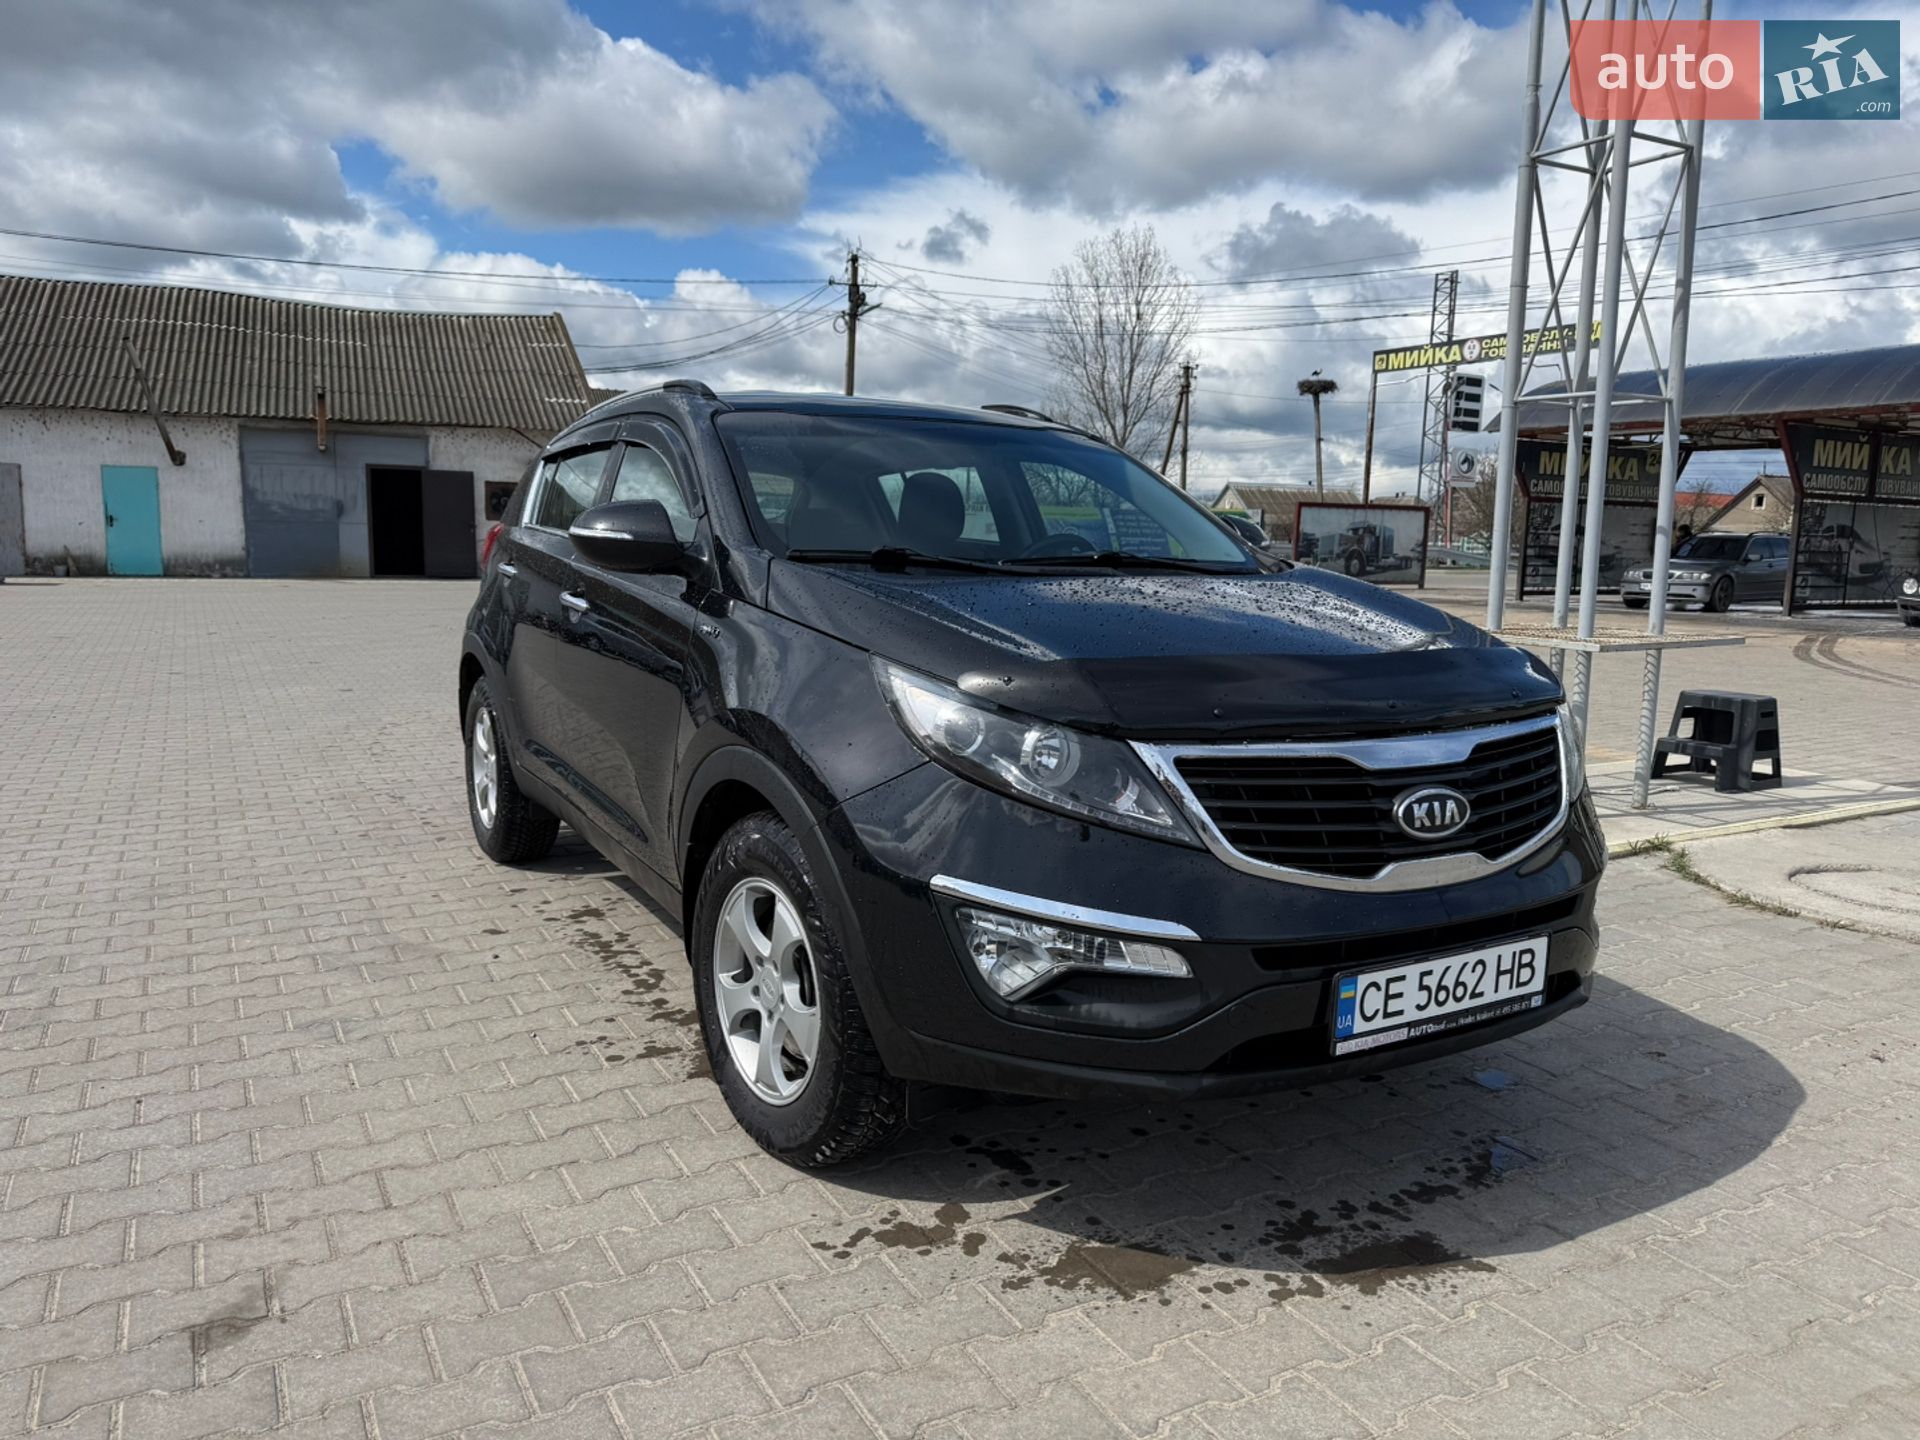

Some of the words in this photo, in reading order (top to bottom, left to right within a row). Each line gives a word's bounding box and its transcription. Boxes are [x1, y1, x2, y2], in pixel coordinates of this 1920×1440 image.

[1388, 344, 1462, 370] МИЙКА
[1411, 799, 1460, 828] KIA
[1359, 974, 1407, 1023] CE
[1415, 958, 1487, 1012] 5662
[1493, 948, 1536, 994] HB
[1337, 1014, 1352, 1029] UA
